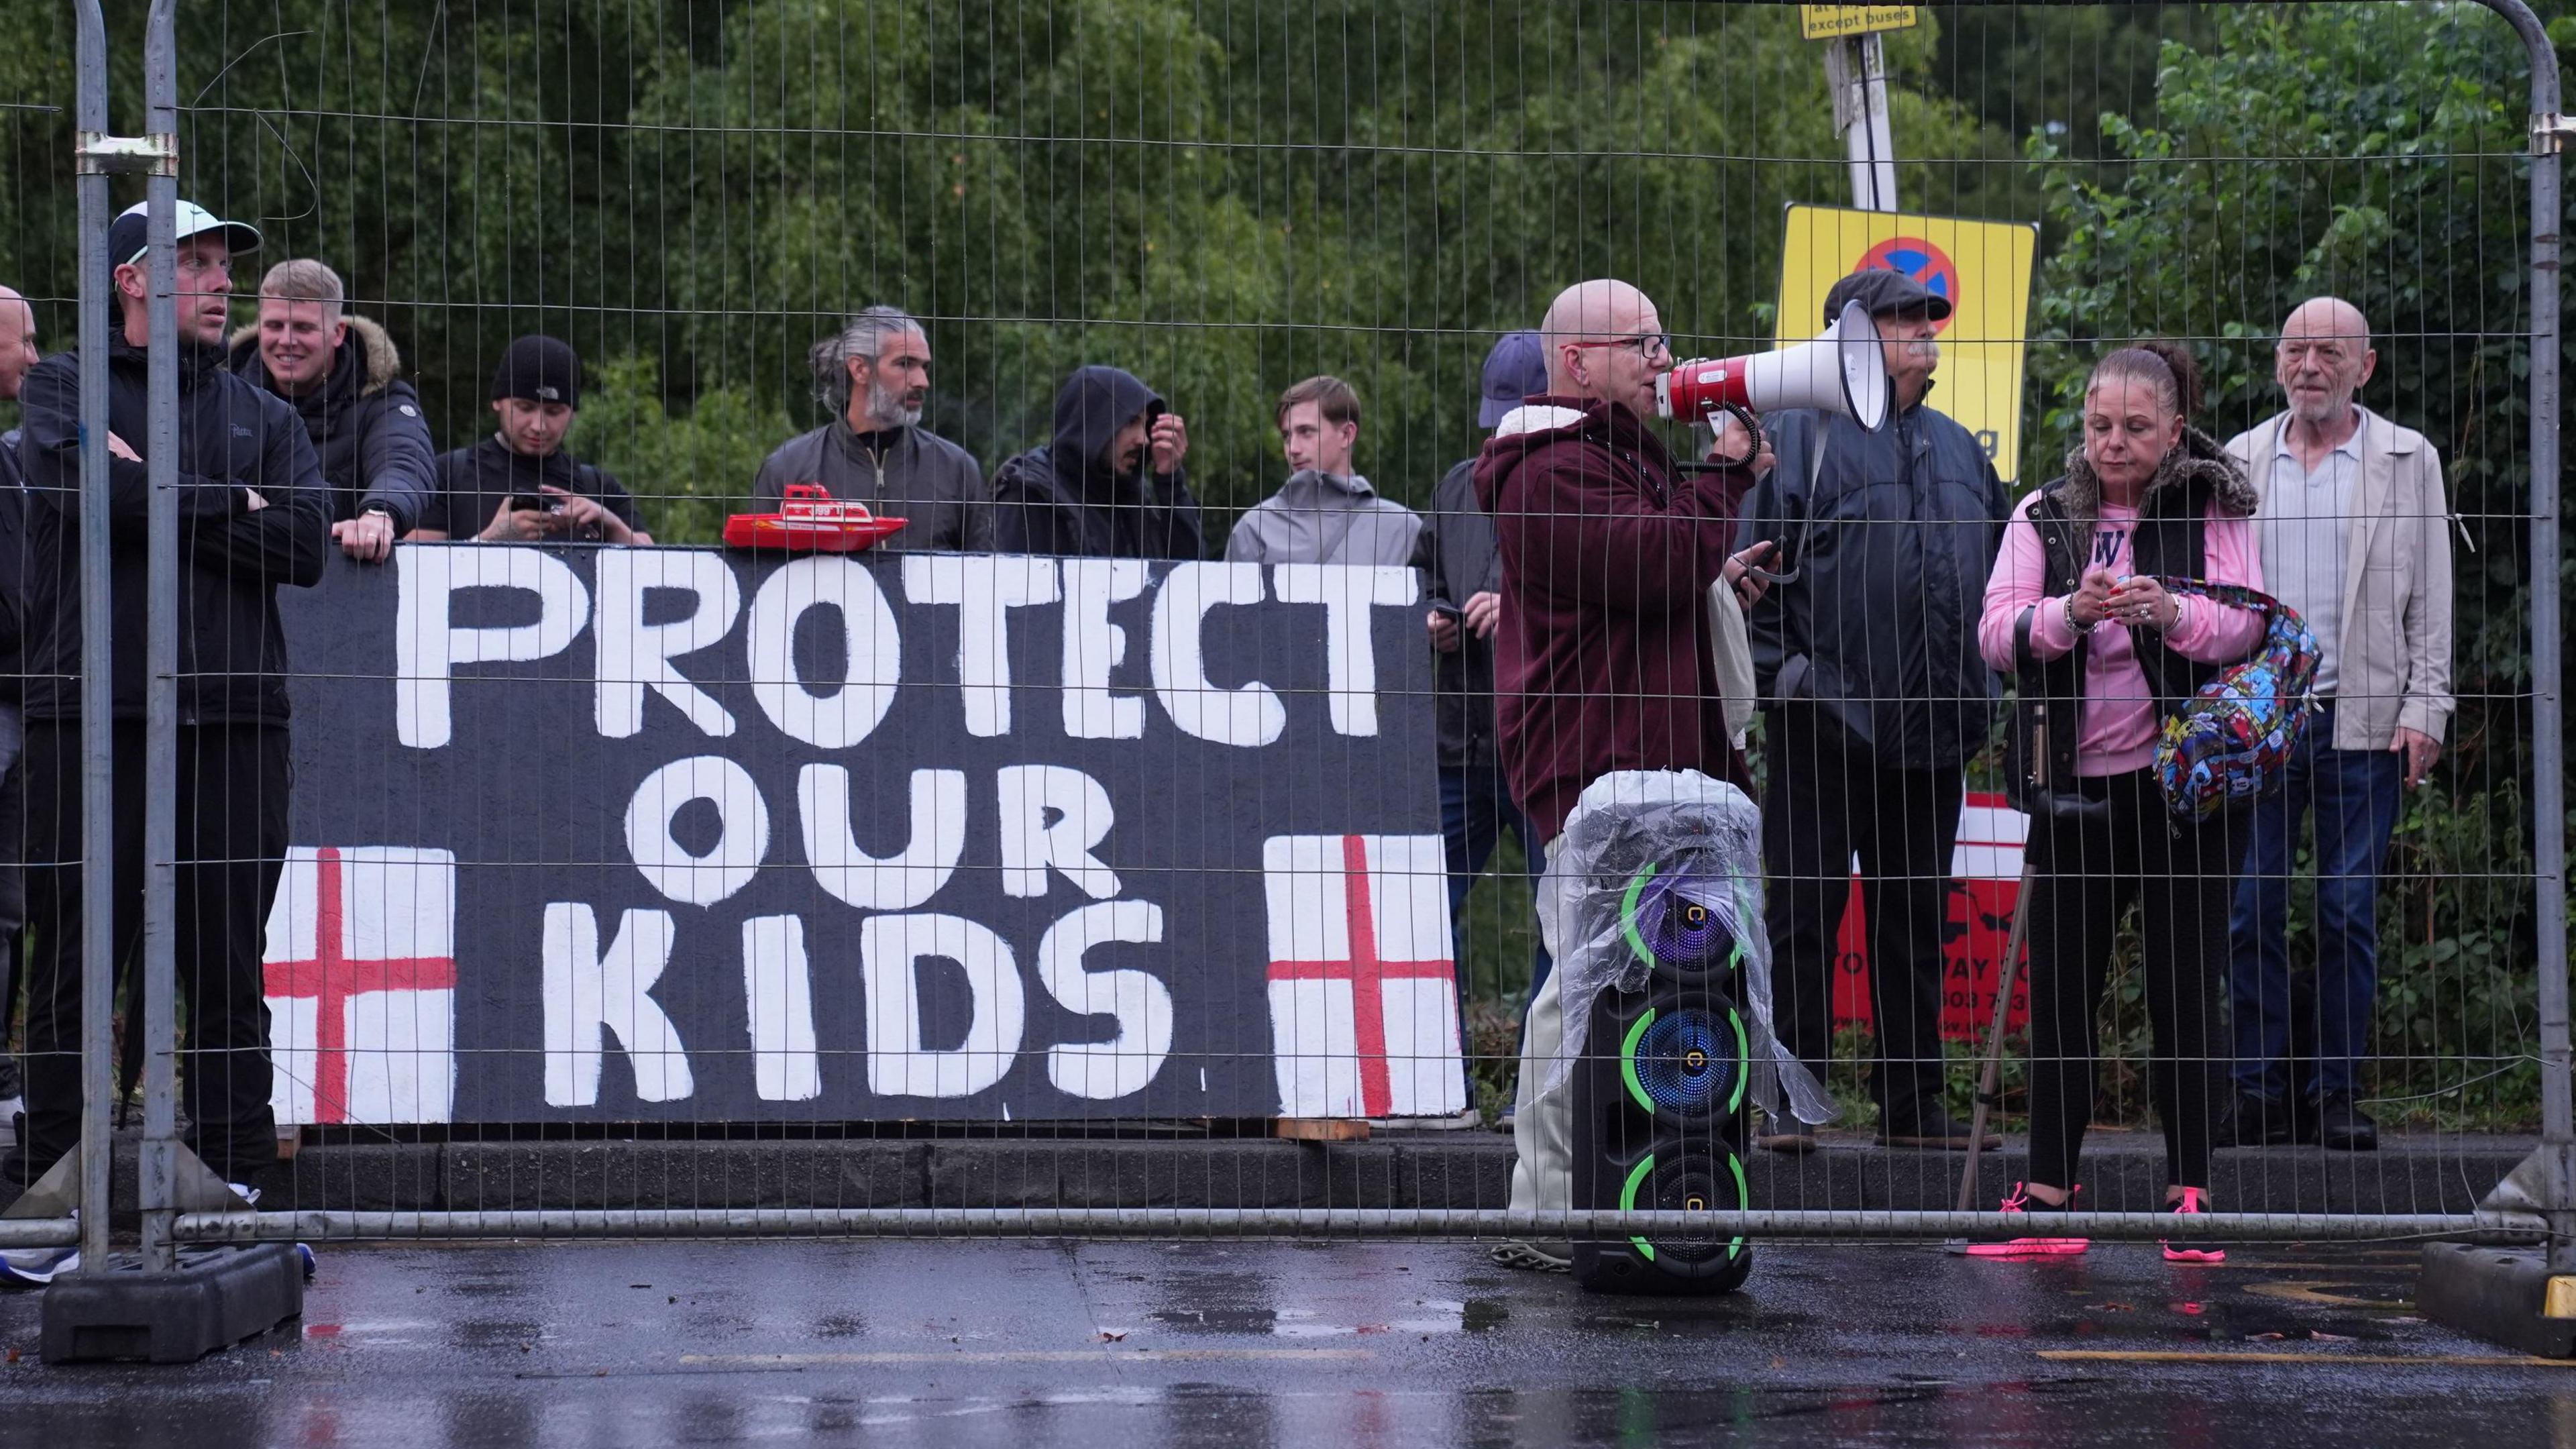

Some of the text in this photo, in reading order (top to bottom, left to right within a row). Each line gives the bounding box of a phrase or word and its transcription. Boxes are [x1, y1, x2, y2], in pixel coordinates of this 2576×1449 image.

[1811, 10, 1910, 32] except buses
[395, 545, 1419, 749] PROTECT
[625, 755, 1120, 910] OUR
[543, 900, 1173, 1110] KIDS
